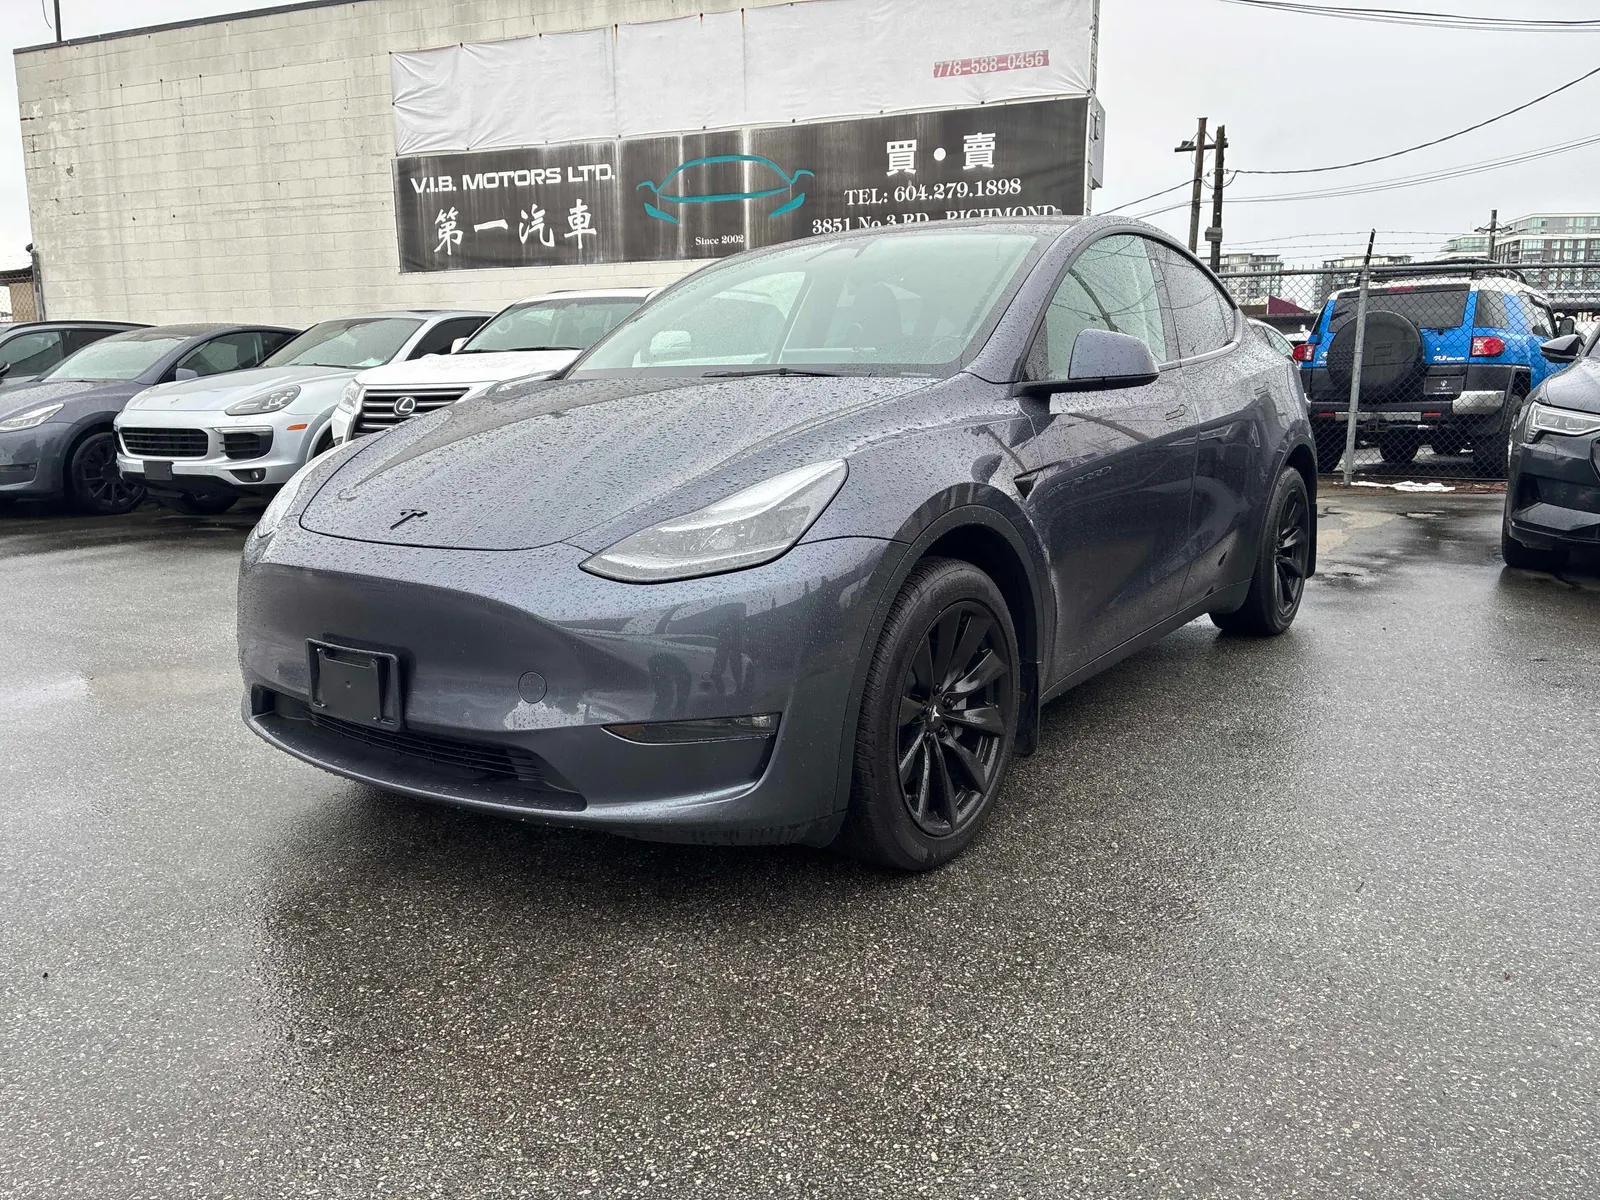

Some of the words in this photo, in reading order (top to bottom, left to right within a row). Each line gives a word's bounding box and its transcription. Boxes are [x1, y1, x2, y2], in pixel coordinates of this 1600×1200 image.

[935, 51, 1044, 76] 778-588-0456
[410, 175, 457, 193] V.I.B.
[462, 167, 562, 190] MOTORS
[567, 163, 616, 182] LTD.
[844, 188, 888, 206] TEL:
[894, 177, 1022, 202] 604.279.1898
[433, 198, 598, 256] 第一汽車
[812, 217, 850, 234] 3851
[945, 204, 1056, 220] RICHMOND
[695, 236, 719, 246] Since
[721, 234, 744, 244] 2002
